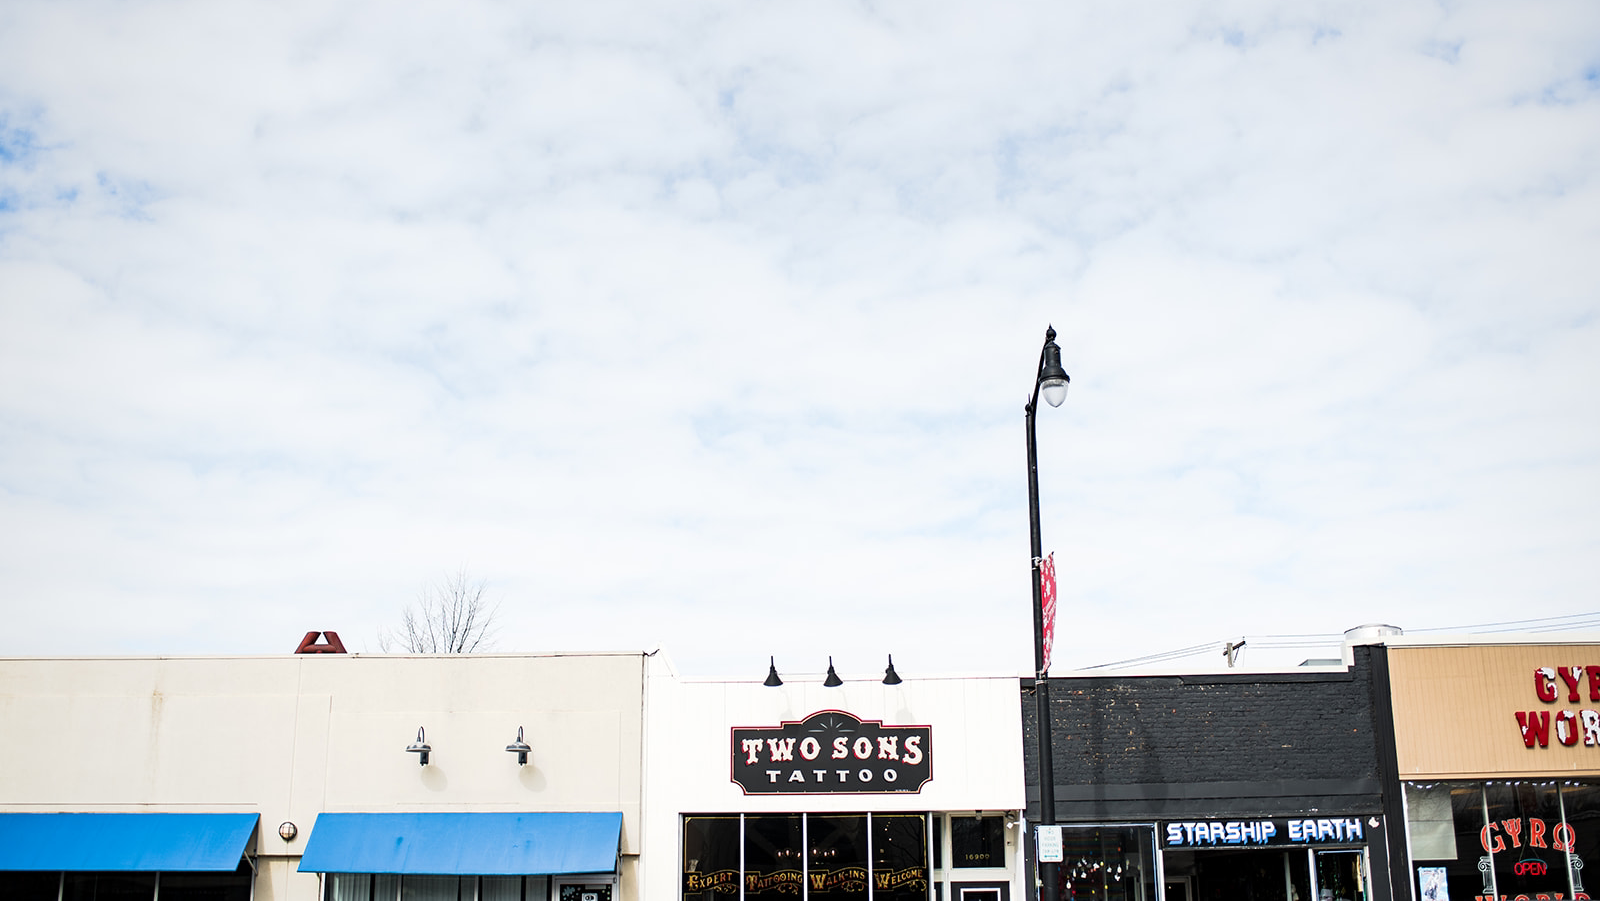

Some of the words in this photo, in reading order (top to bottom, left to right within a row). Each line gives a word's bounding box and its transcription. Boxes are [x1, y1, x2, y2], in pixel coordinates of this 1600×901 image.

[1514, 708, 1600, 748] WOR
[741, 736, 821, 765] TWO
[831, 735, 923, 765] SONS
[765, 768, 898, 783] TATTOO
[1166, 820, 1276, 846] STARSHIP
[1287, 818, 1363, 843] EARTH
[686, 872, 733, 892] EXPERT
[875, 868, 923, 889] WELCOME
[1514, 862, 1547, 876] OPEN
